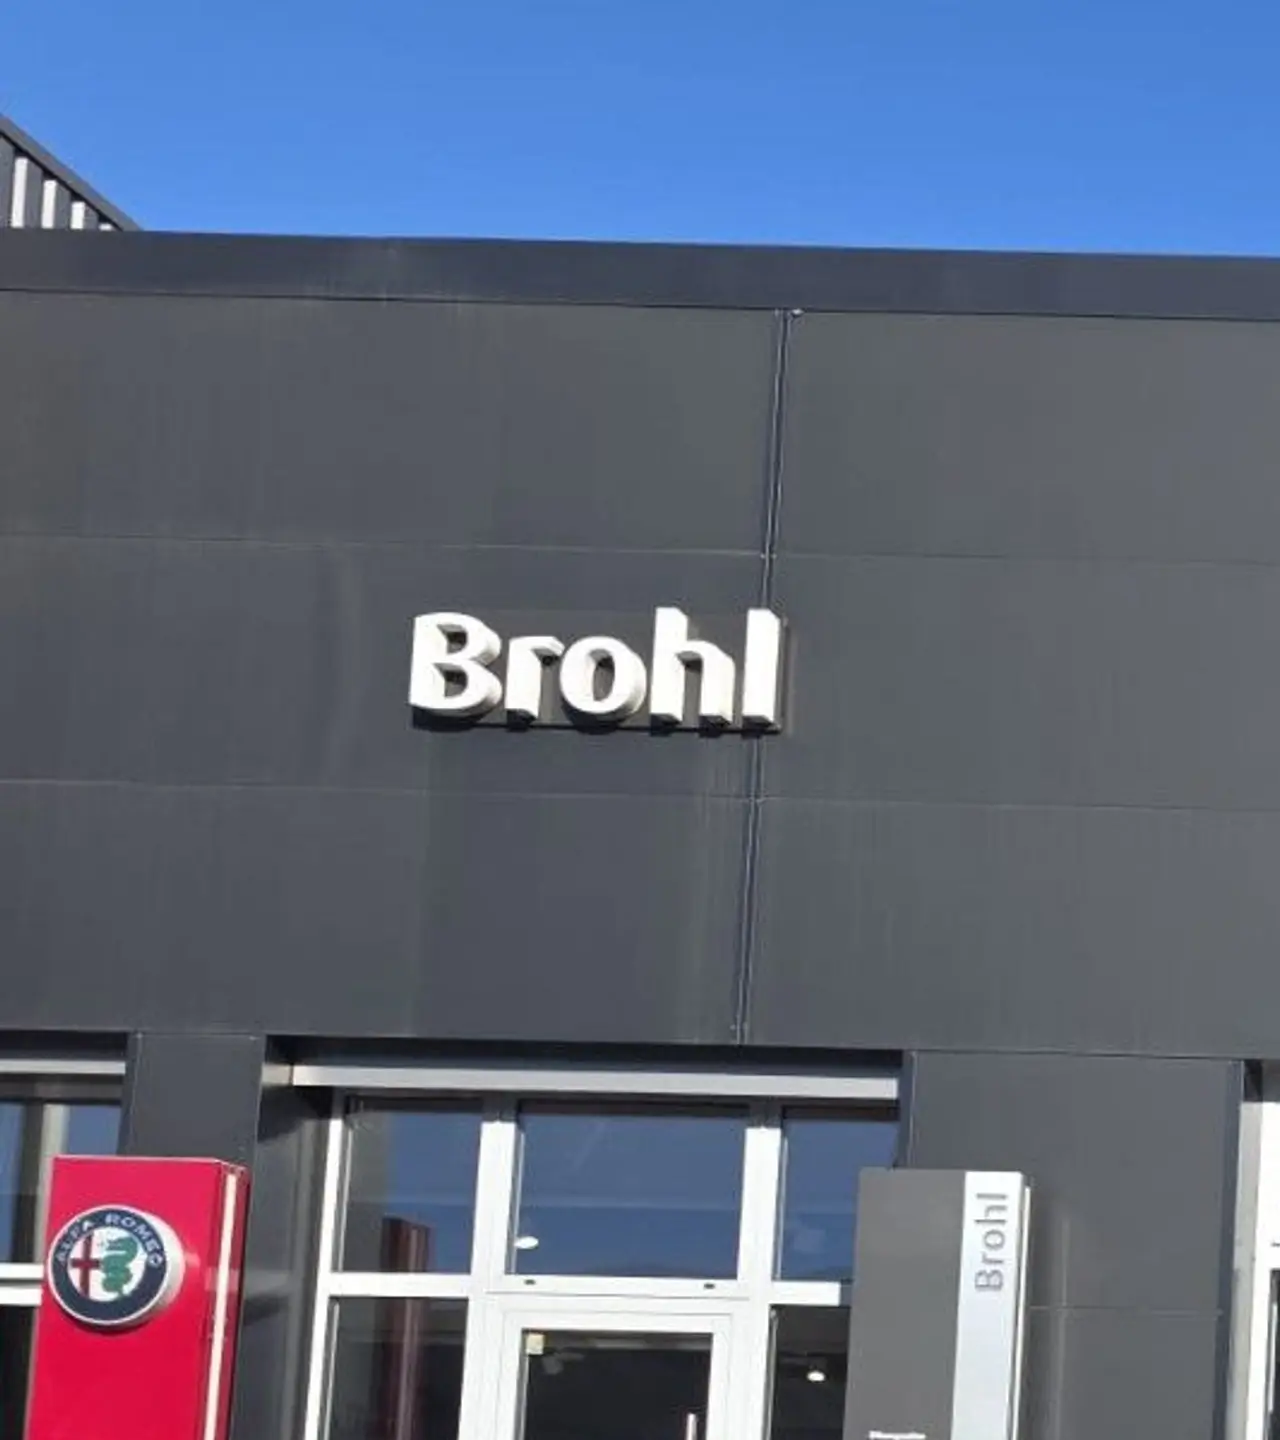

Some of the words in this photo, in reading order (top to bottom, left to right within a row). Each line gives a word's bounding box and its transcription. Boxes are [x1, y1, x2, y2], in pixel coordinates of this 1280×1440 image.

[408, 606, 782, 725] Brohl
[55, 1220, 94, 1263] ALFA
[105, 1212, 163, 1268] ROMEO
[973, 1192, 1009, 1292] Brohl
